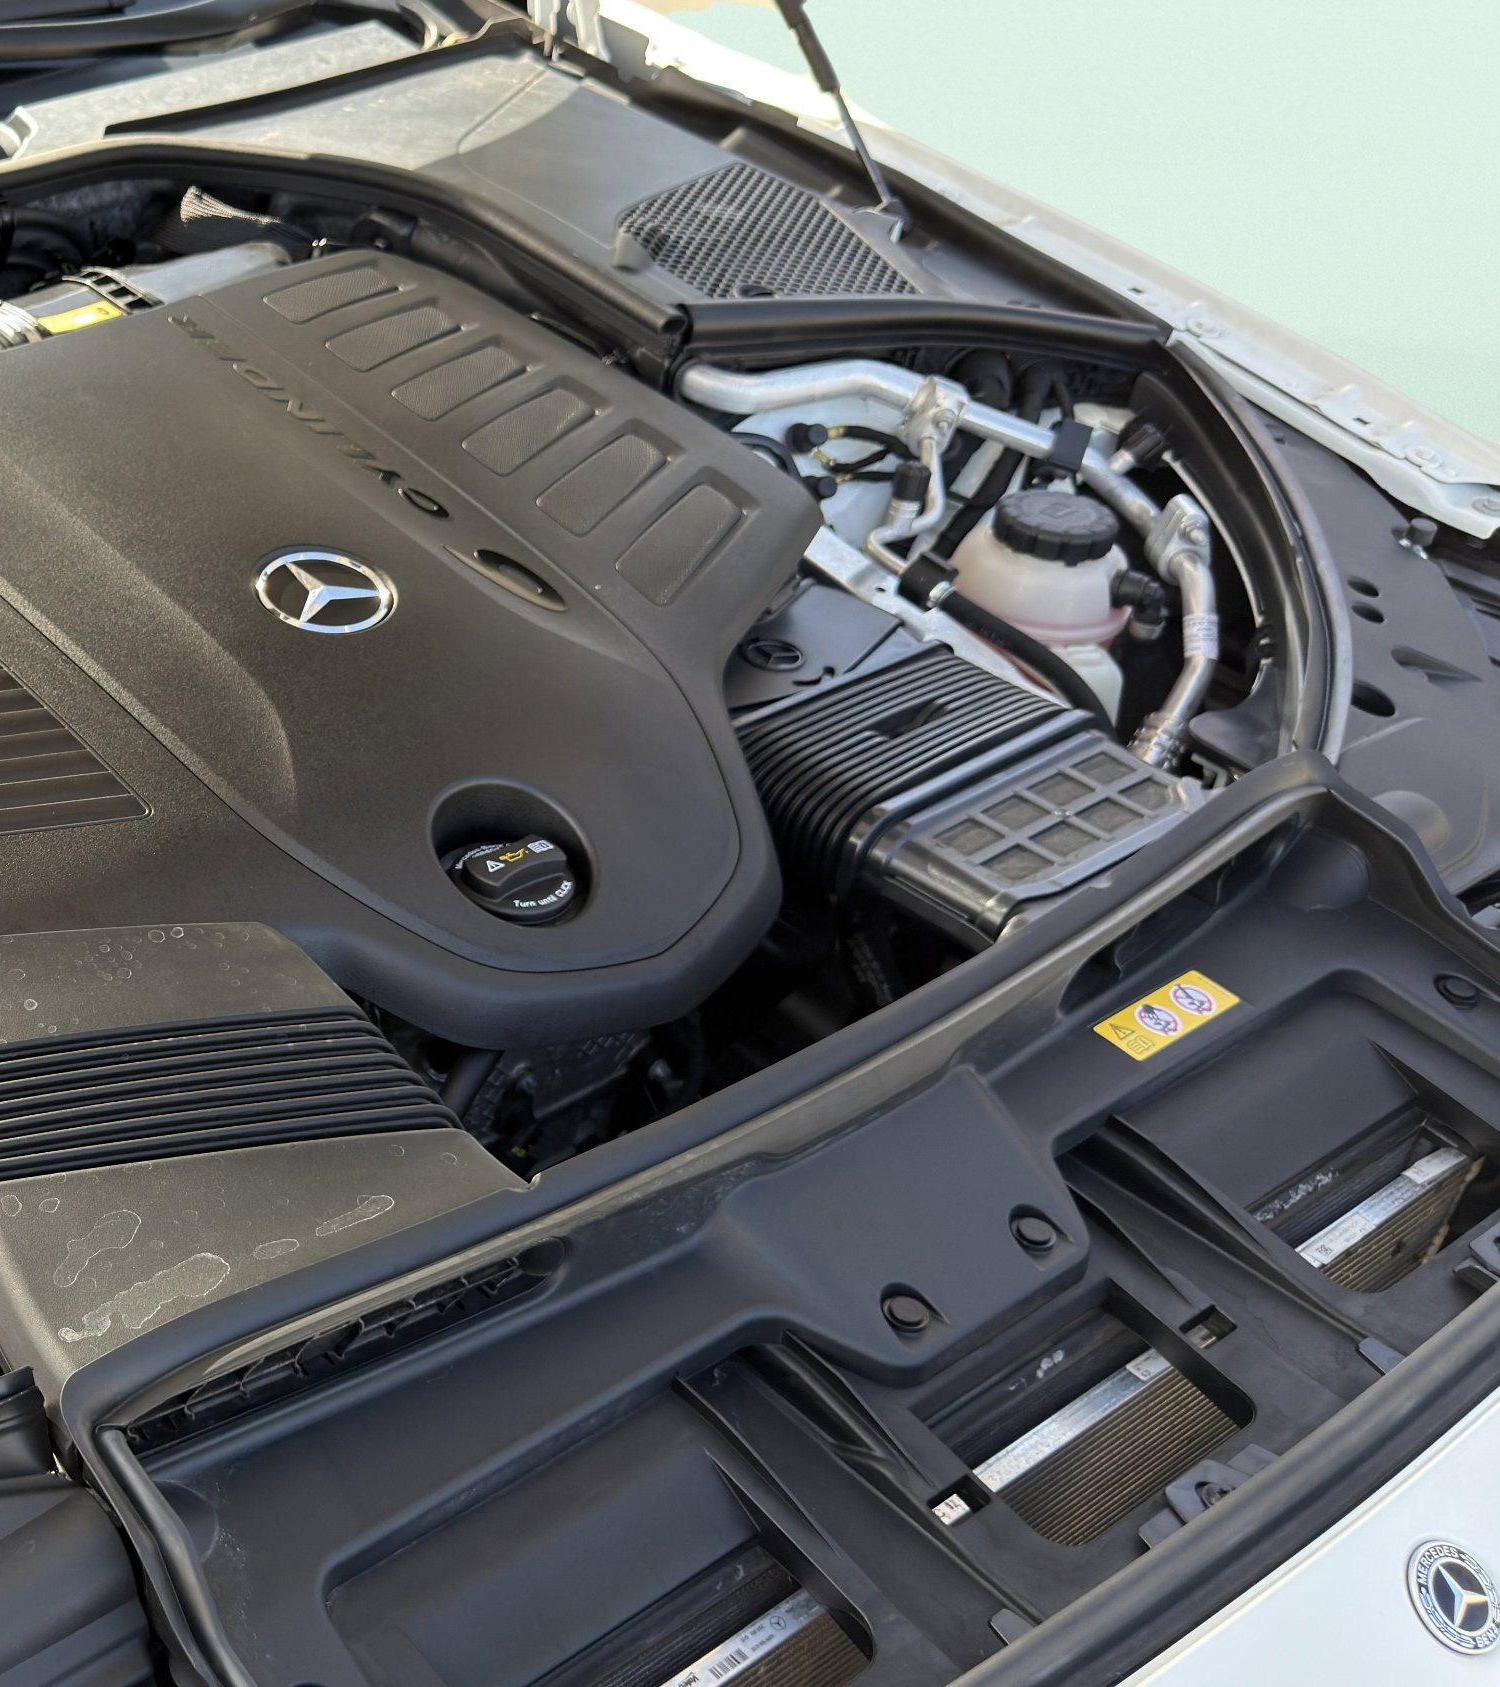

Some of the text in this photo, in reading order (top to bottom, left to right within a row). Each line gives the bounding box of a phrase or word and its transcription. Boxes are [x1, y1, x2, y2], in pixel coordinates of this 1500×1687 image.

[513, 899, 537, 908] Turn
[537, 894, 558, 906] until
[1417, 1545, 1460, 1586] MERCEDES
[1475, 1621, 1500, 1649] BENZ
